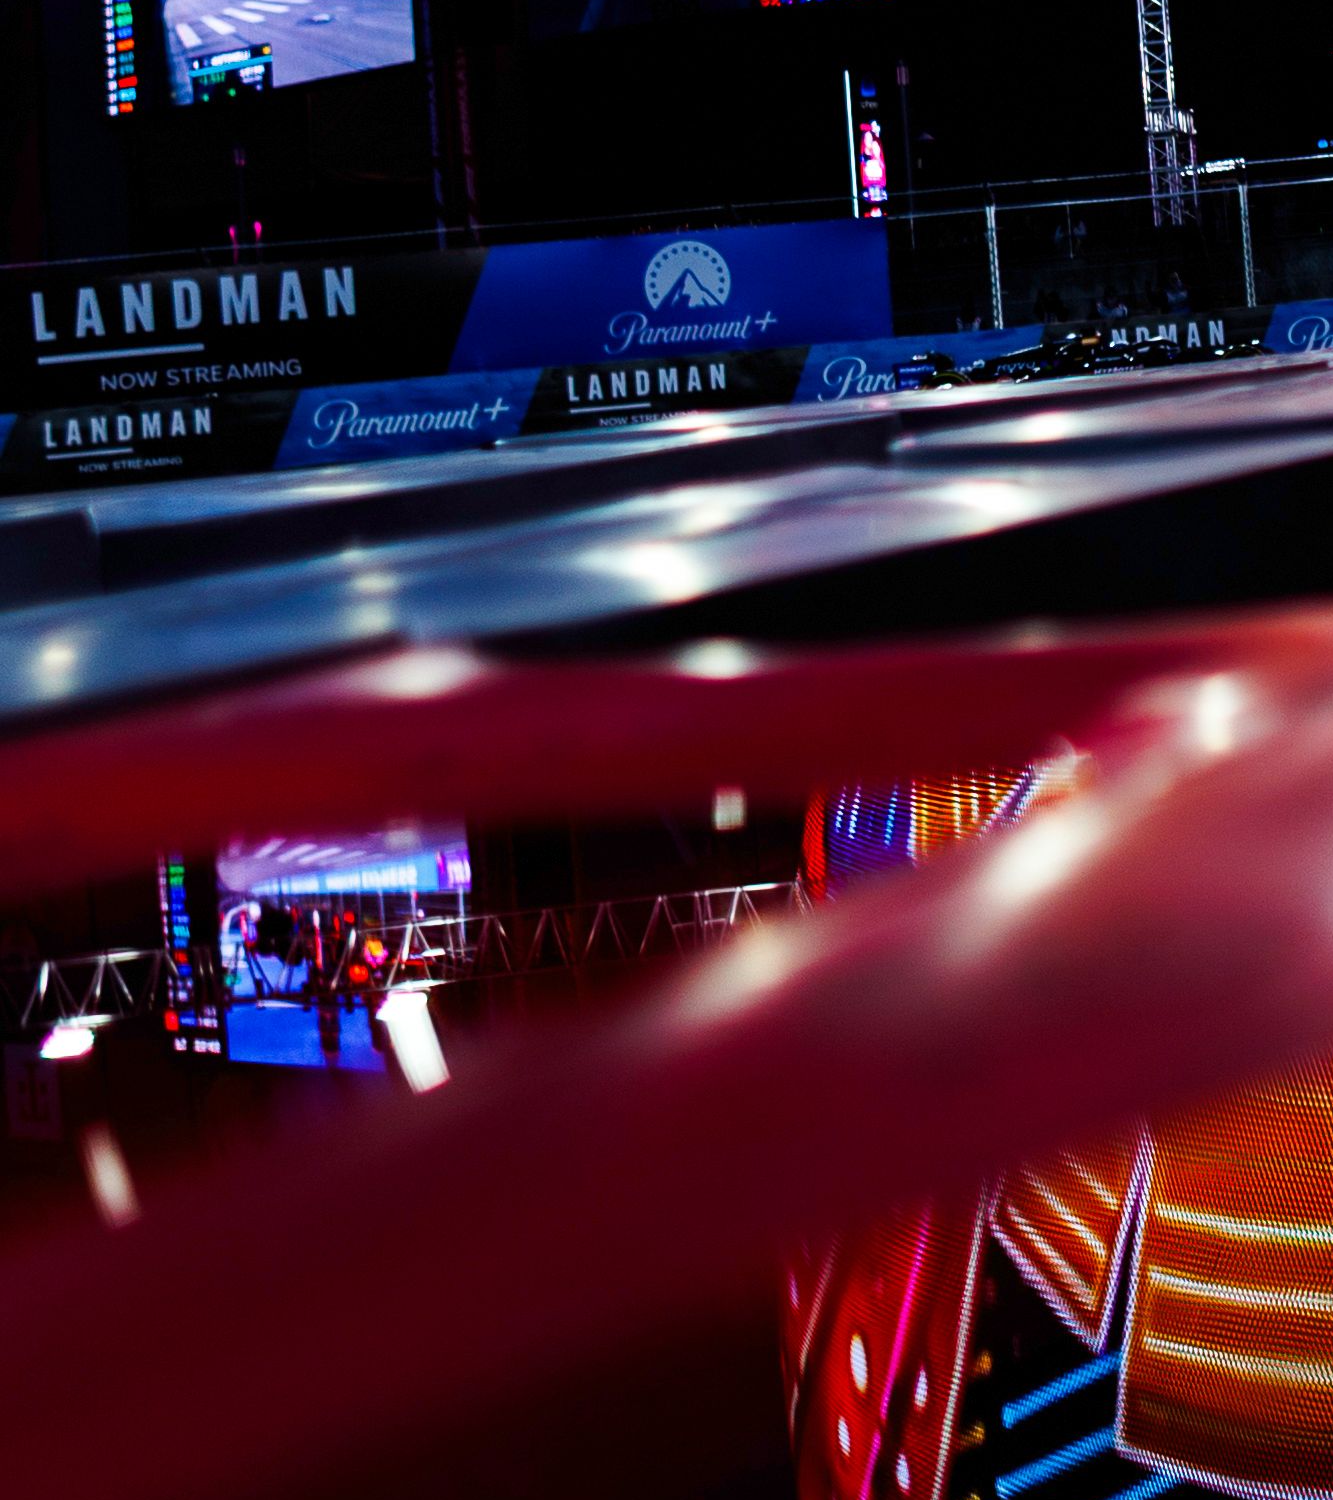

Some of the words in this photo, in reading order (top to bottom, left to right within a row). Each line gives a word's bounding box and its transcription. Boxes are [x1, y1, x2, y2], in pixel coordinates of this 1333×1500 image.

[31, 265, 357, 342] LANDMAN
[604, 310, 778, 355] Paramount+
[1110, 318, 1226, 349] NDMAN
[100, 370, 158, 392] NOW
[166, 358, 302, 387] STREAMING
[566, 362, 728, 402] LANDMAN
[44, 407, 213, 449] LANDMAN
[306, 394, 511, 451] Paramount+
[78, 462, 108, 474] NOW
[112, 456, 183, 472] STREAMING
